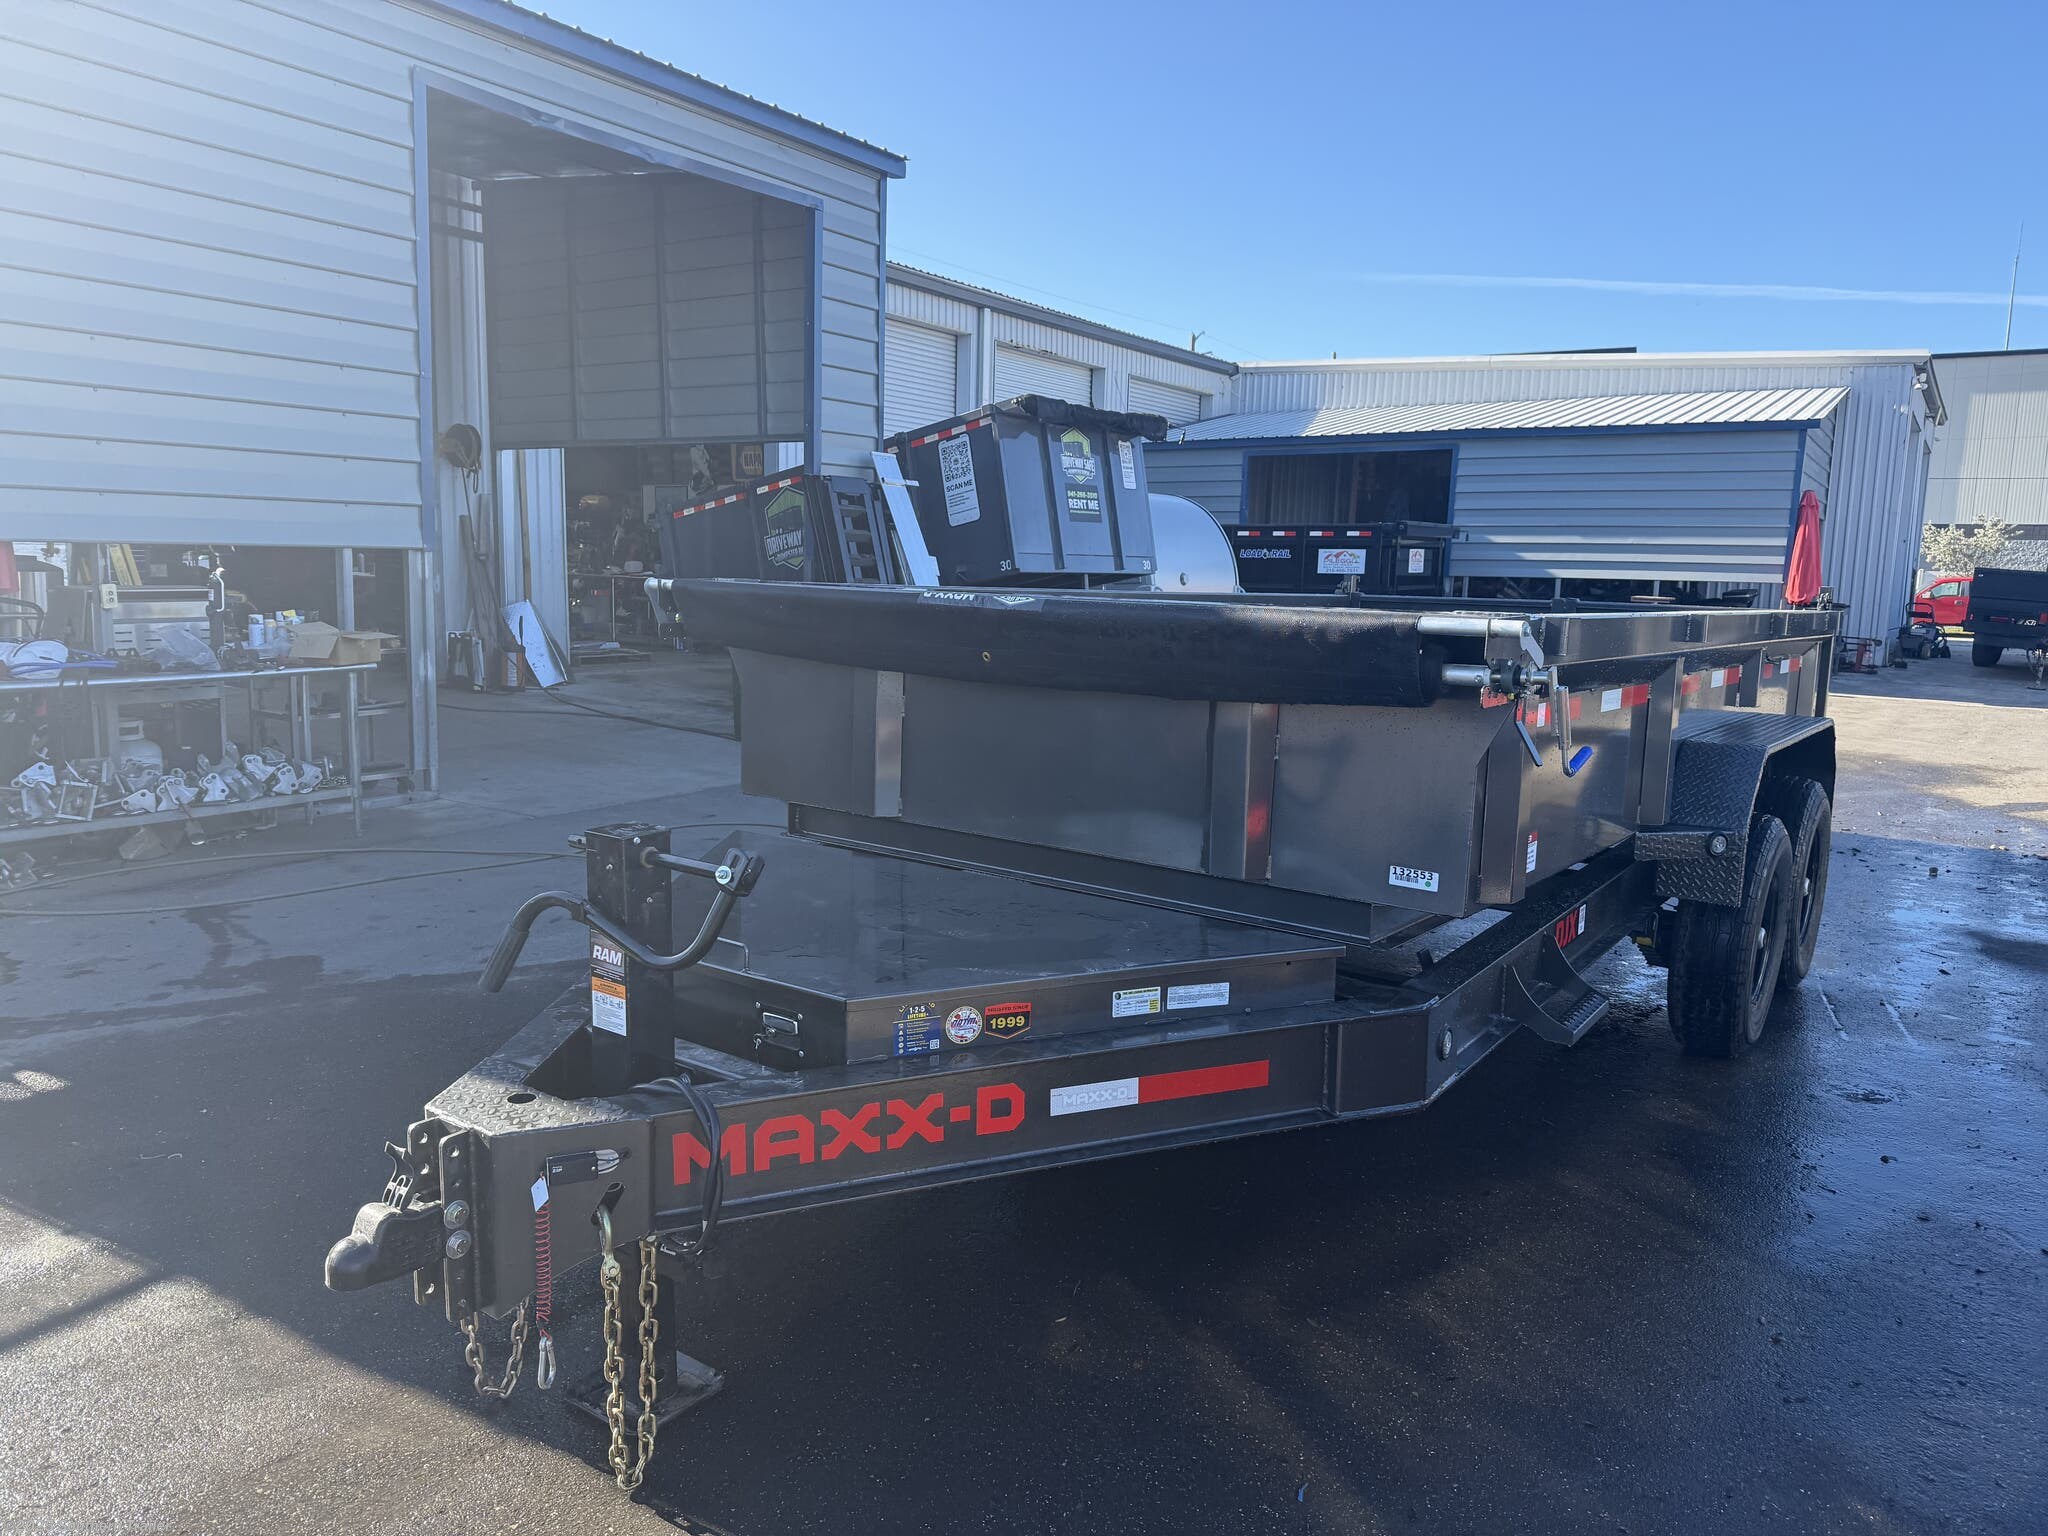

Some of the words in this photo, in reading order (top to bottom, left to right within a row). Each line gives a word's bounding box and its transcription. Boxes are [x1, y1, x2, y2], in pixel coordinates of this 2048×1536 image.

[946, 481, 963, 493] SCAN
[964, 479, 973, 487] ME
[1068, 498, 1087, 510] RENT
[1087, 500, 1099, 510] ME
[767, 530, 802, 555] DRIVEWAY
[1240, 549, 1263, 558] LOAD
[1000, 560, 1012, 571] 30
[1142, 560, 1151, 570] 30
[1392, 866, 1434, 881] 132553
[593, 944, 623, 966] RAM
[990, 1015, 1026, 1029] 1999
[1063, 1087, 1128, 1106] MAXX-D
[672, 1083, 1026, 1186] MAXX-D
